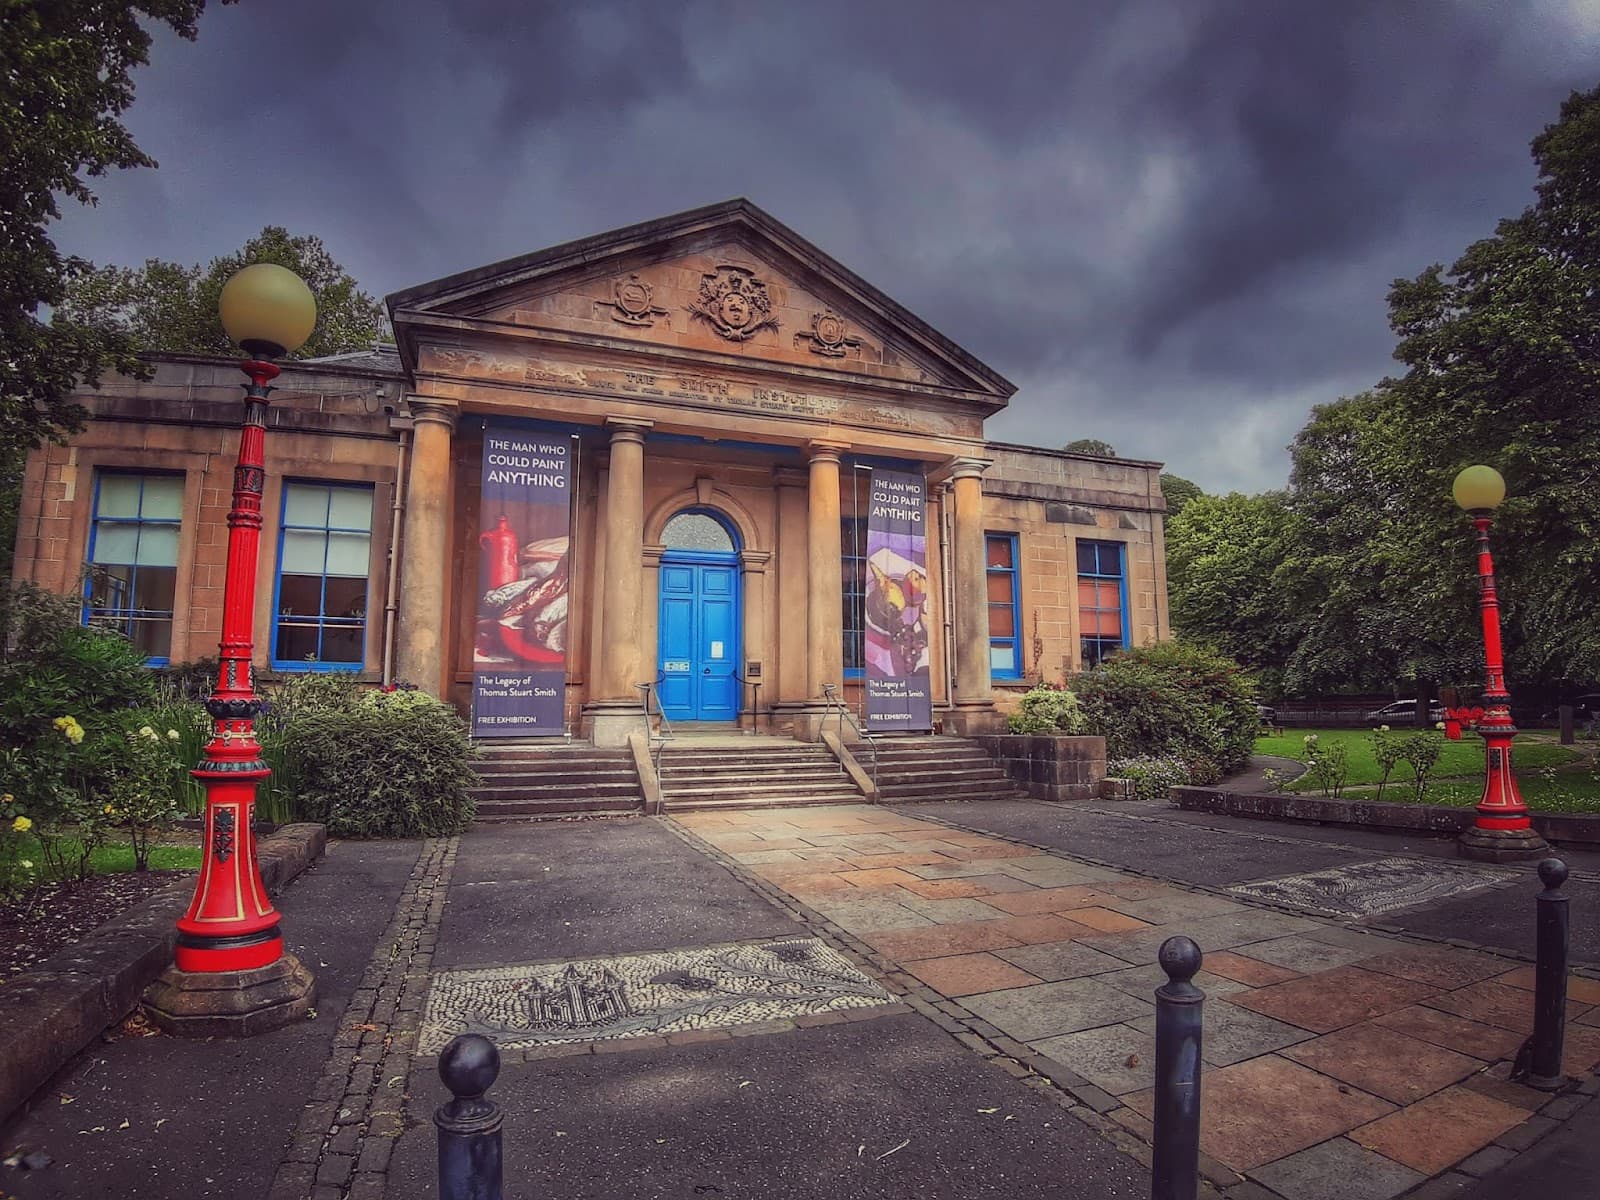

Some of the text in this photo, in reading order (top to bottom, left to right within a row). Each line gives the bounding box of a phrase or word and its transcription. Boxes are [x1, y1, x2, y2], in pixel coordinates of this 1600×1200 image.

[625, 372, 655, 386] THE
[680, 378, 729, 396] SMITH
[489, 439, 566, 455] THE MAN WHO
[488, 454, 565, 470] COULD PAINT
[487, 470, 565, 488] ANYTHING
[875, 479, 888, 489] THE
[873, 492, 899, 504] COUD
[872, 506, 921, 522] ANYTHING
[479, 676, 532, 687] The Legacy of
[479, 688, 557, 697] Thomas Stuart Smith
[478, 716, 537, 724] FREE EXHIBITION
